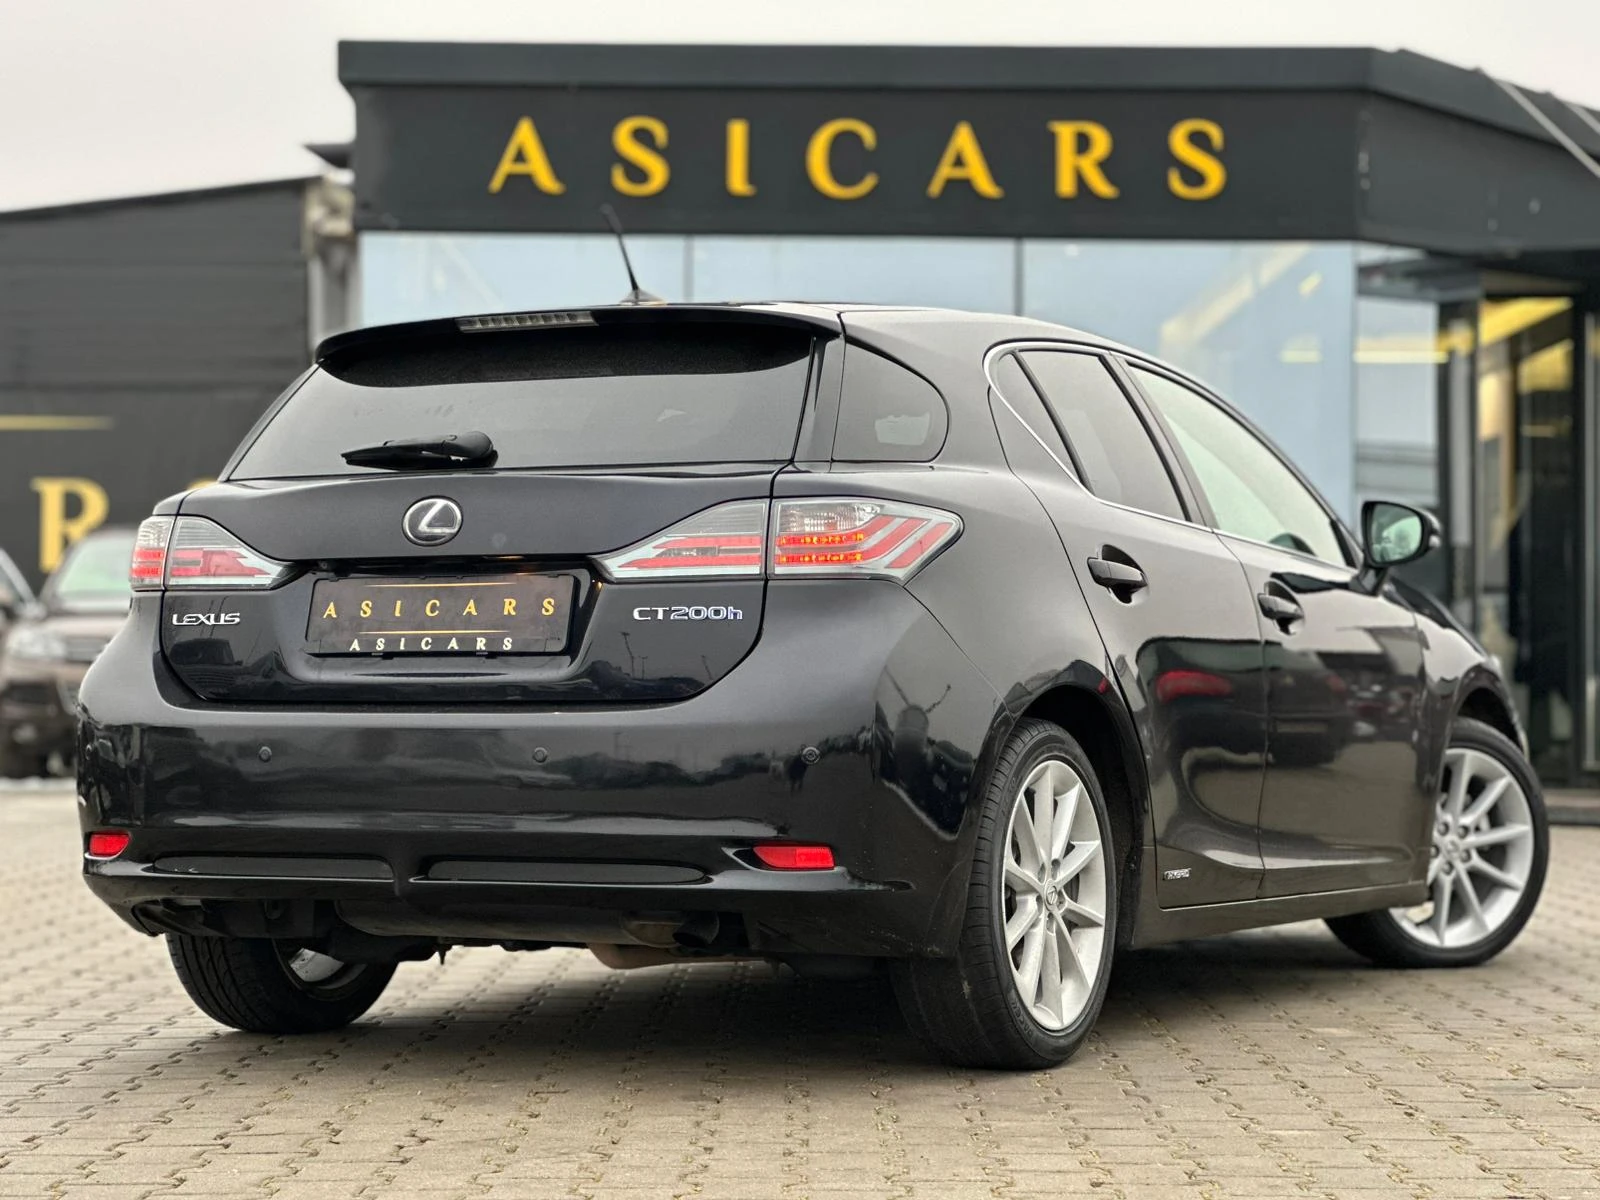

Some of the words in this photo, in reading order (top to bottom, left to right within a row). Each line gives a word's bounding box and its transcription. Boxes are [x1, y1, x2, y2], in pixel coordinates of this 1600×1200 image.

[488, 116, 1227, 199] ASICARS
[322, 597, 556, 619] ASICARS
[632, 605, 743, 621] CT200h
[172, 612, 241, 626] LEXUS
[349, 636, 513, 652] ASICARS
